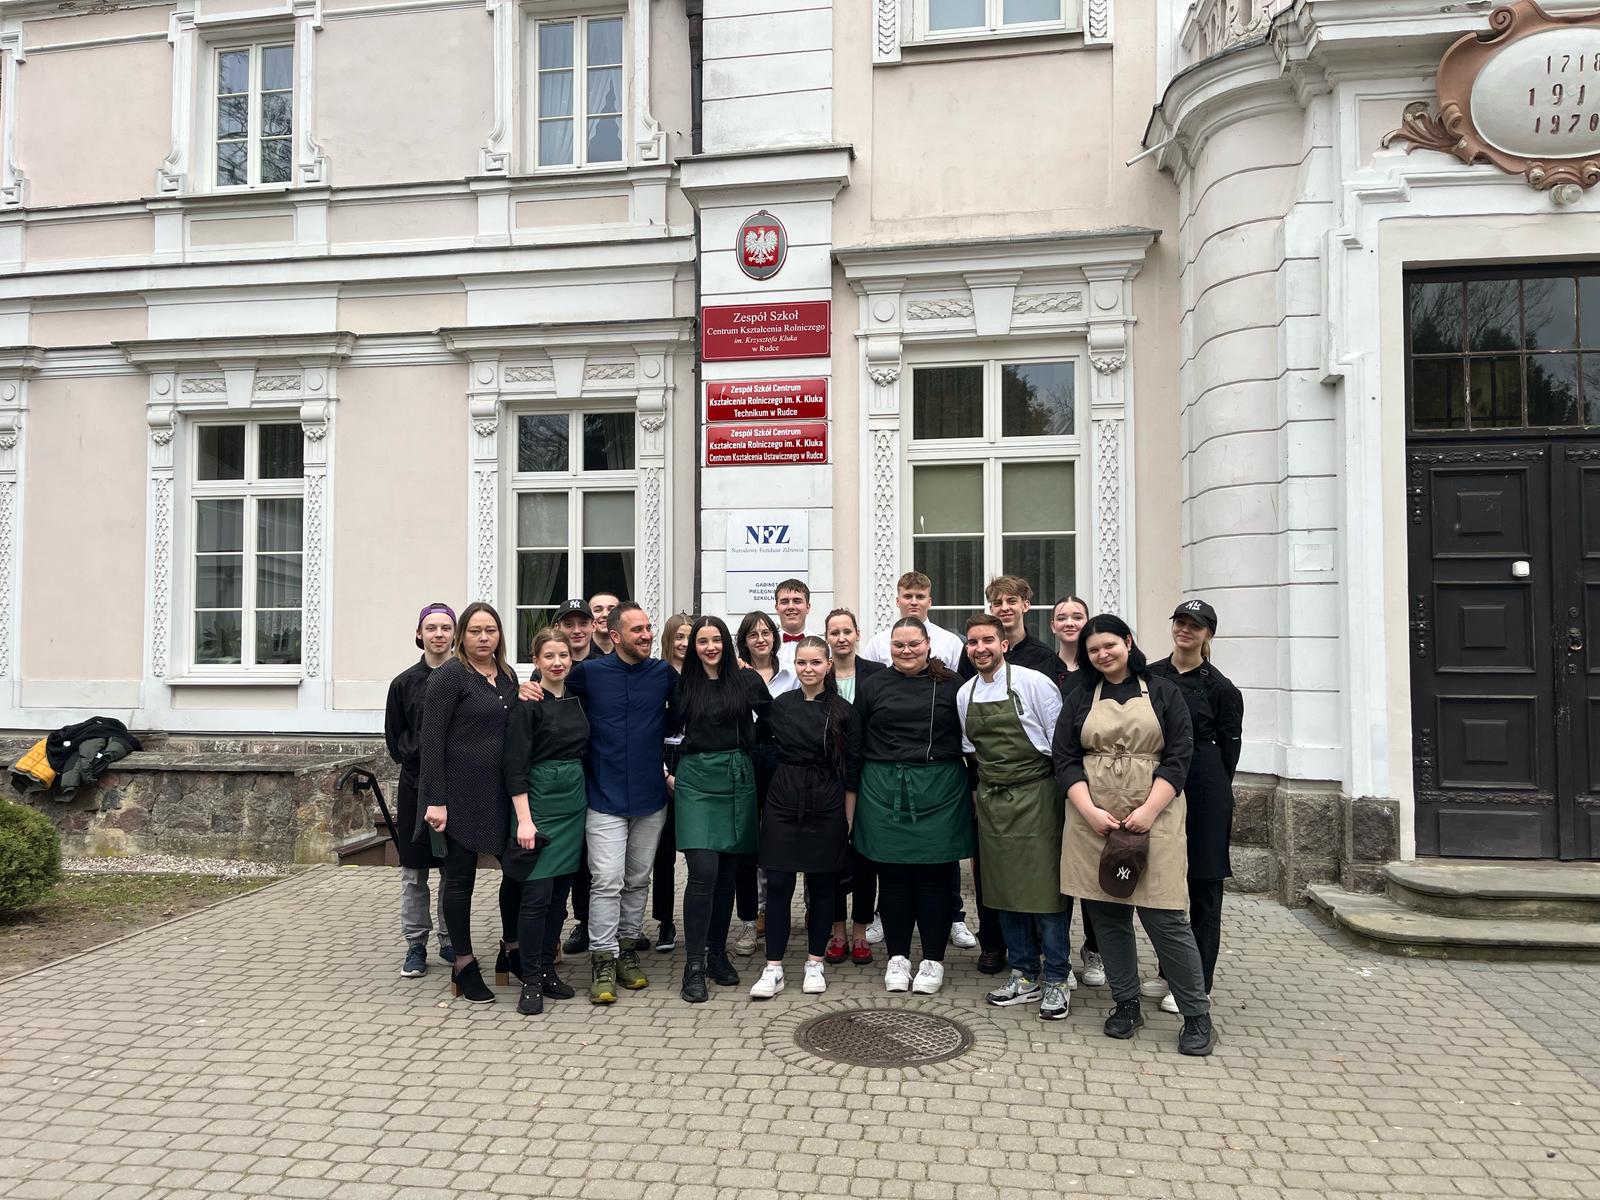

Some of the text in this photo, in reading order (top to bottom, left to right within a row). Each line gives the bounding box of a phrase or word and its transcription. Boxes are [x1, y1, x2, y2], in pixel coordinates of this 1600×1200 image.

[1528, 83, 1586, 106] 191
[1534, 113, 1600, 135] 1970
[733, 311, 767, 324] Zespół
[707, 323, 826, 336] Centrum Kształcenia Rolniczego
[772, 384, 802, 392] Centrum
[747, 396, 784, 406] Rolniczego
[784, 395, 794, 404] im.
[796, 395, 803, 404] K.
[804, 394, 824, 403] Kluka
[734, 408, 768, 418] Technikum
[776, 408, 798, 416] Rudce
[772, 428, 802, 436] Centrum
[747, 440, 784, 450] Rolniczego
[784, 439, 794, 448] im.
[796, 439, 803, 448] K.
[804, 438, 824, 447] Kluka
[709, 454, 732, 462] Centrum
[764, 452, 800, 462] Ustawicznego
[806, 452, 824, 460] Rudce
[745, 524, 790, 544] NFZ
[1117, 866, 1131, 879] NY
